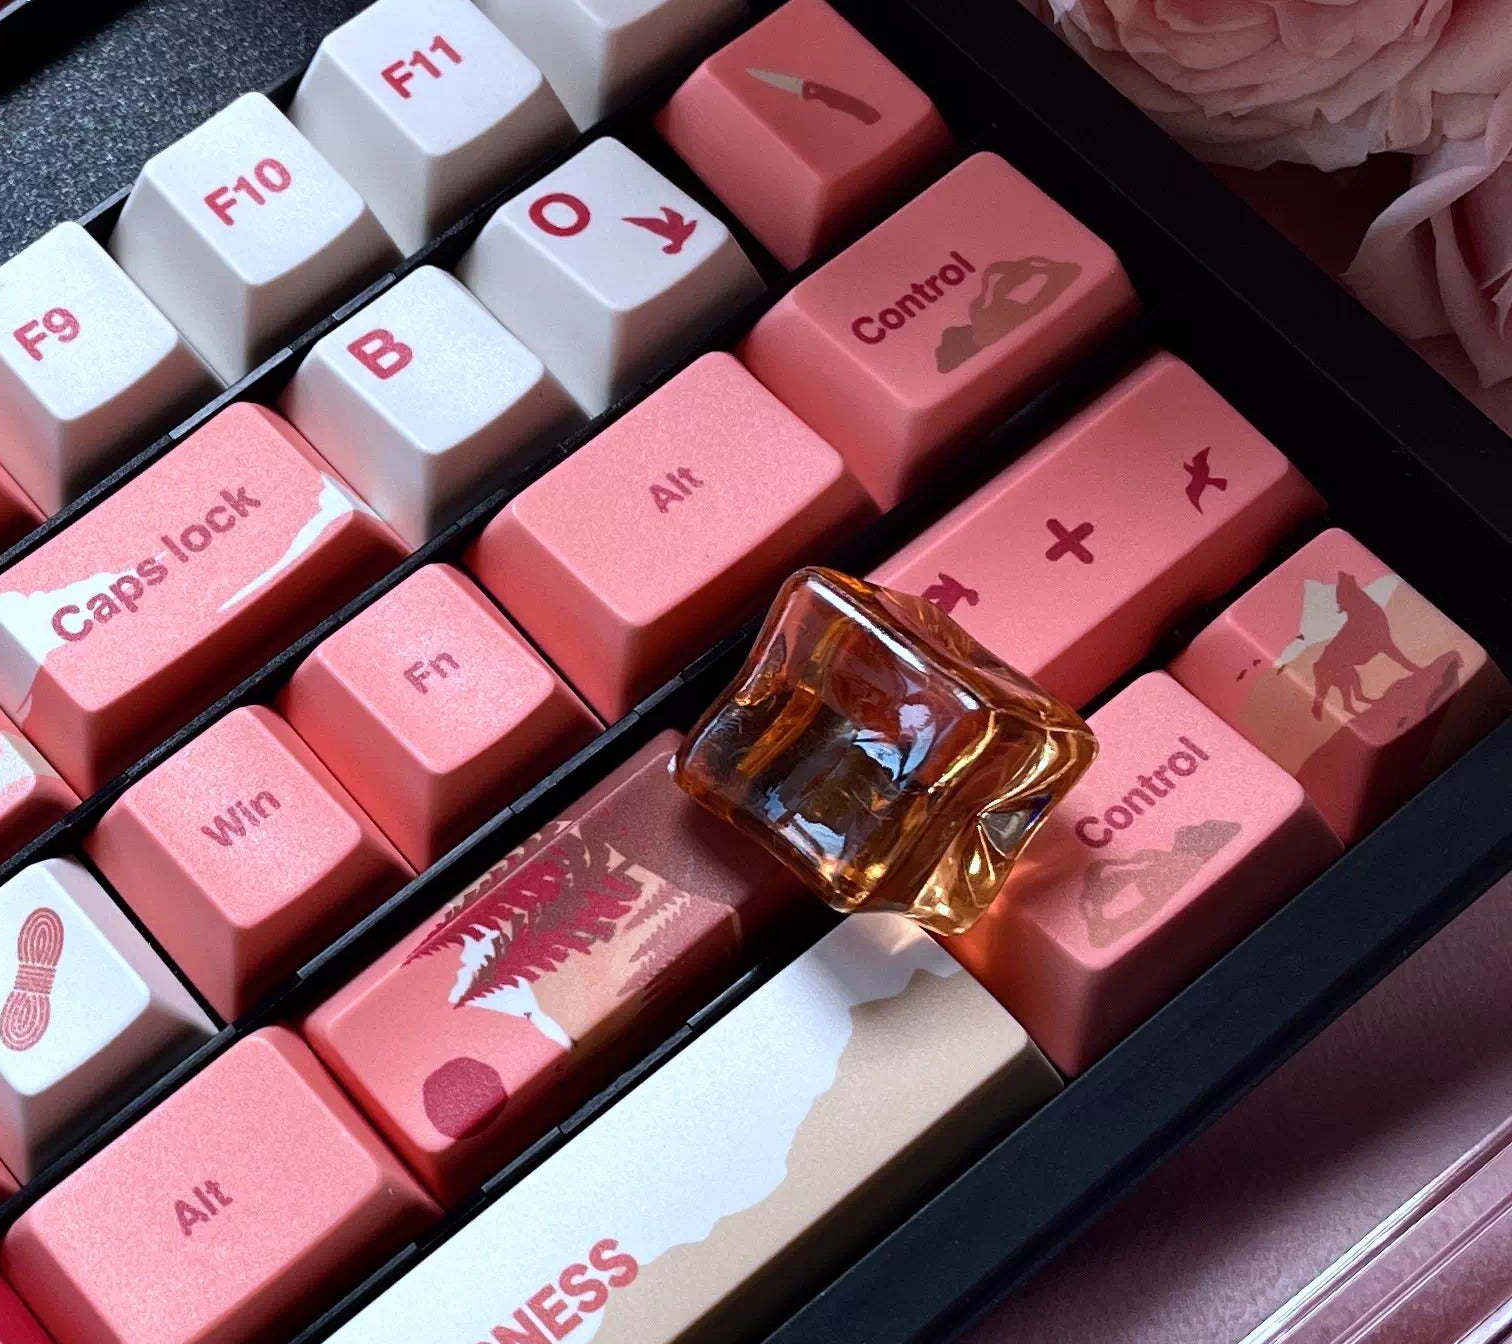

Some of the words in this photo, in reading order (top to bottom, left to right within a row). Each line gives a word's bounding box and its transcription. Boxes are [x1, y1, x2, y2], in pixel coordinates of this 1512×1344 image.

[380, 35, 463, 99] F11
[204, 157, 292, 226] F10
[850, 251, 977, 345] Control
[14, 306, 82, 362] F9
[347, 329, 414, 379] B
[649, 465, 705, 514] Alt
[51, 556, 169, 643] Caps
[160, 480, 262, 565] lock
[404, 651, 461, 694] Fn
[201, 786, 283, 848] Win
[1076, 734, 1210, 849] Control
[172, 1179, 234, 1236] Alt
